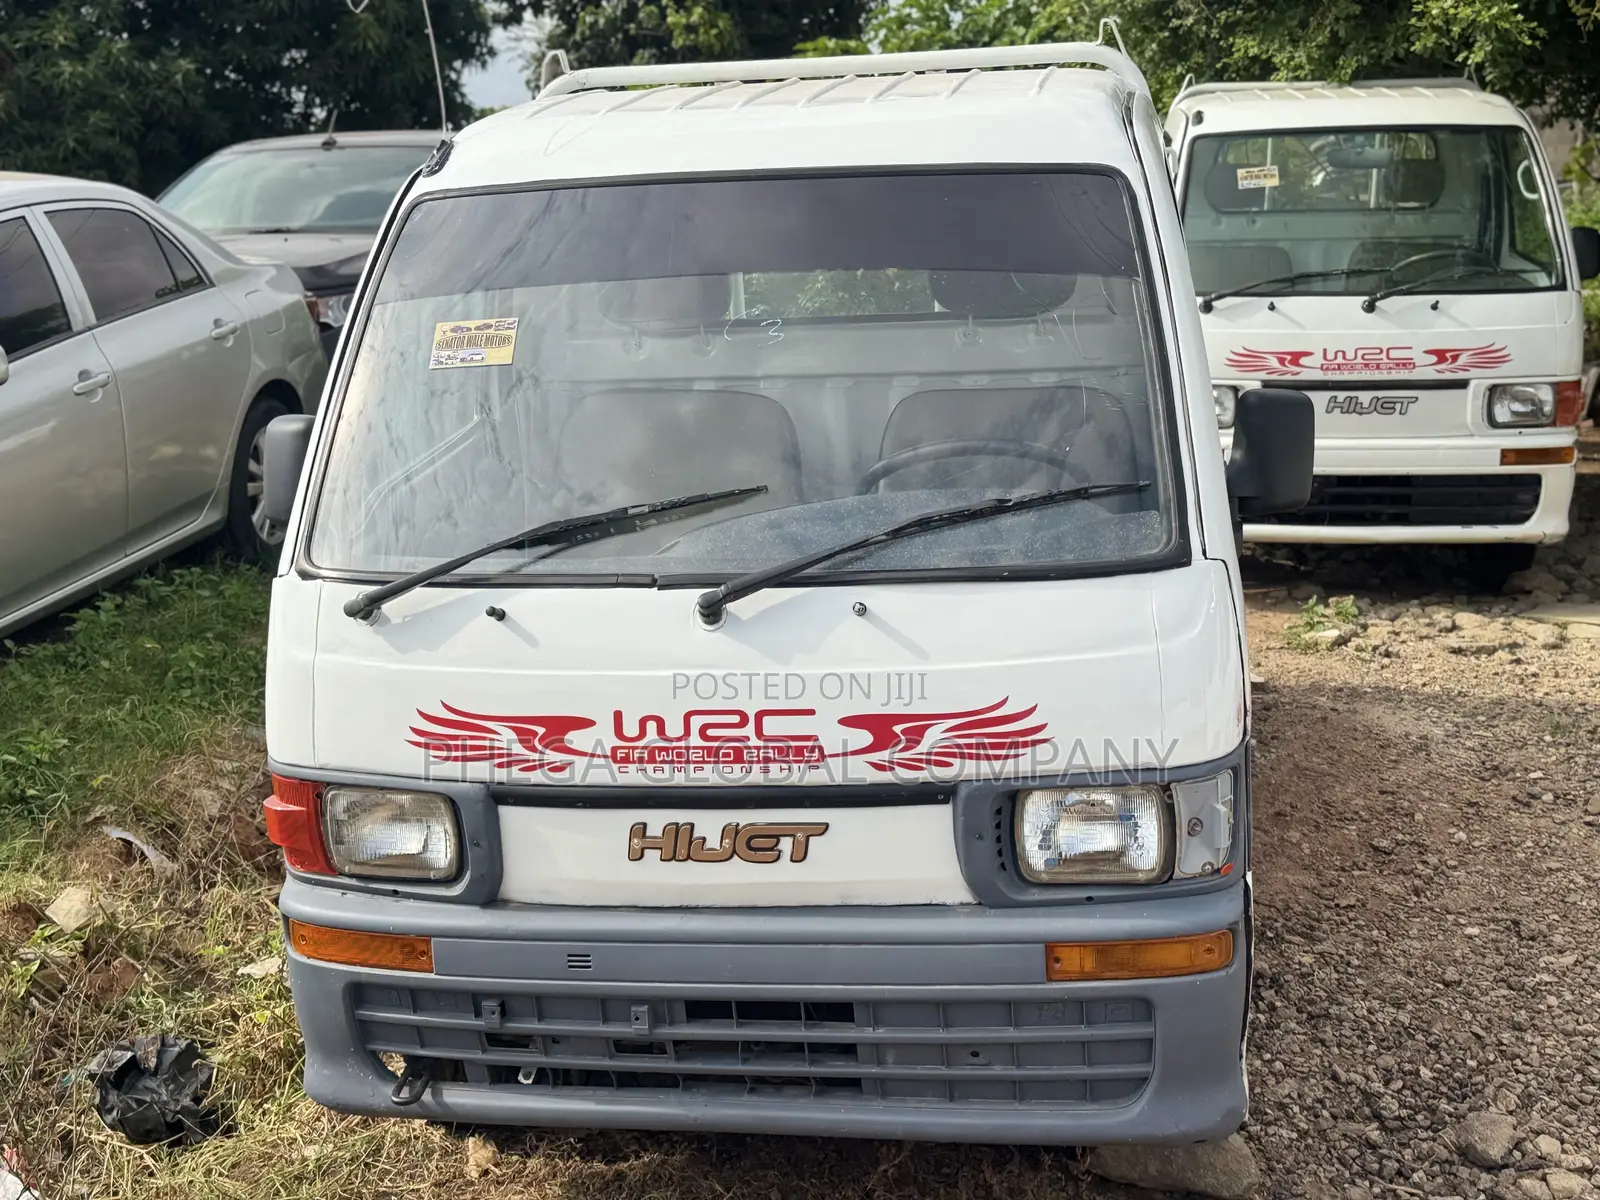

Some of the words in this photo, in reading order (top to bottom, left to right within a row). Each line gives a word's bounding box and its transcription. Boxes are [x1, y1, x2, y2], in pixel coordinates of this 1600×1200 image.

[437, 335, 466, 349] SENATOR
[484, 334, 511, 347] MOTORS
[1322, 346, 1414, 362] WRC
[1325, 395, 1419, 416] HIJET
[613, 708, 819, 743] WRC
[616, 749, 649, 761] FIA
[655, 748, 734, 761] WORLD
[743, 748, 819, 761] RALLY
[618, 765, 820, 774] CHAMPIONSHIP
[628, 821, 829, 863] HIJET
